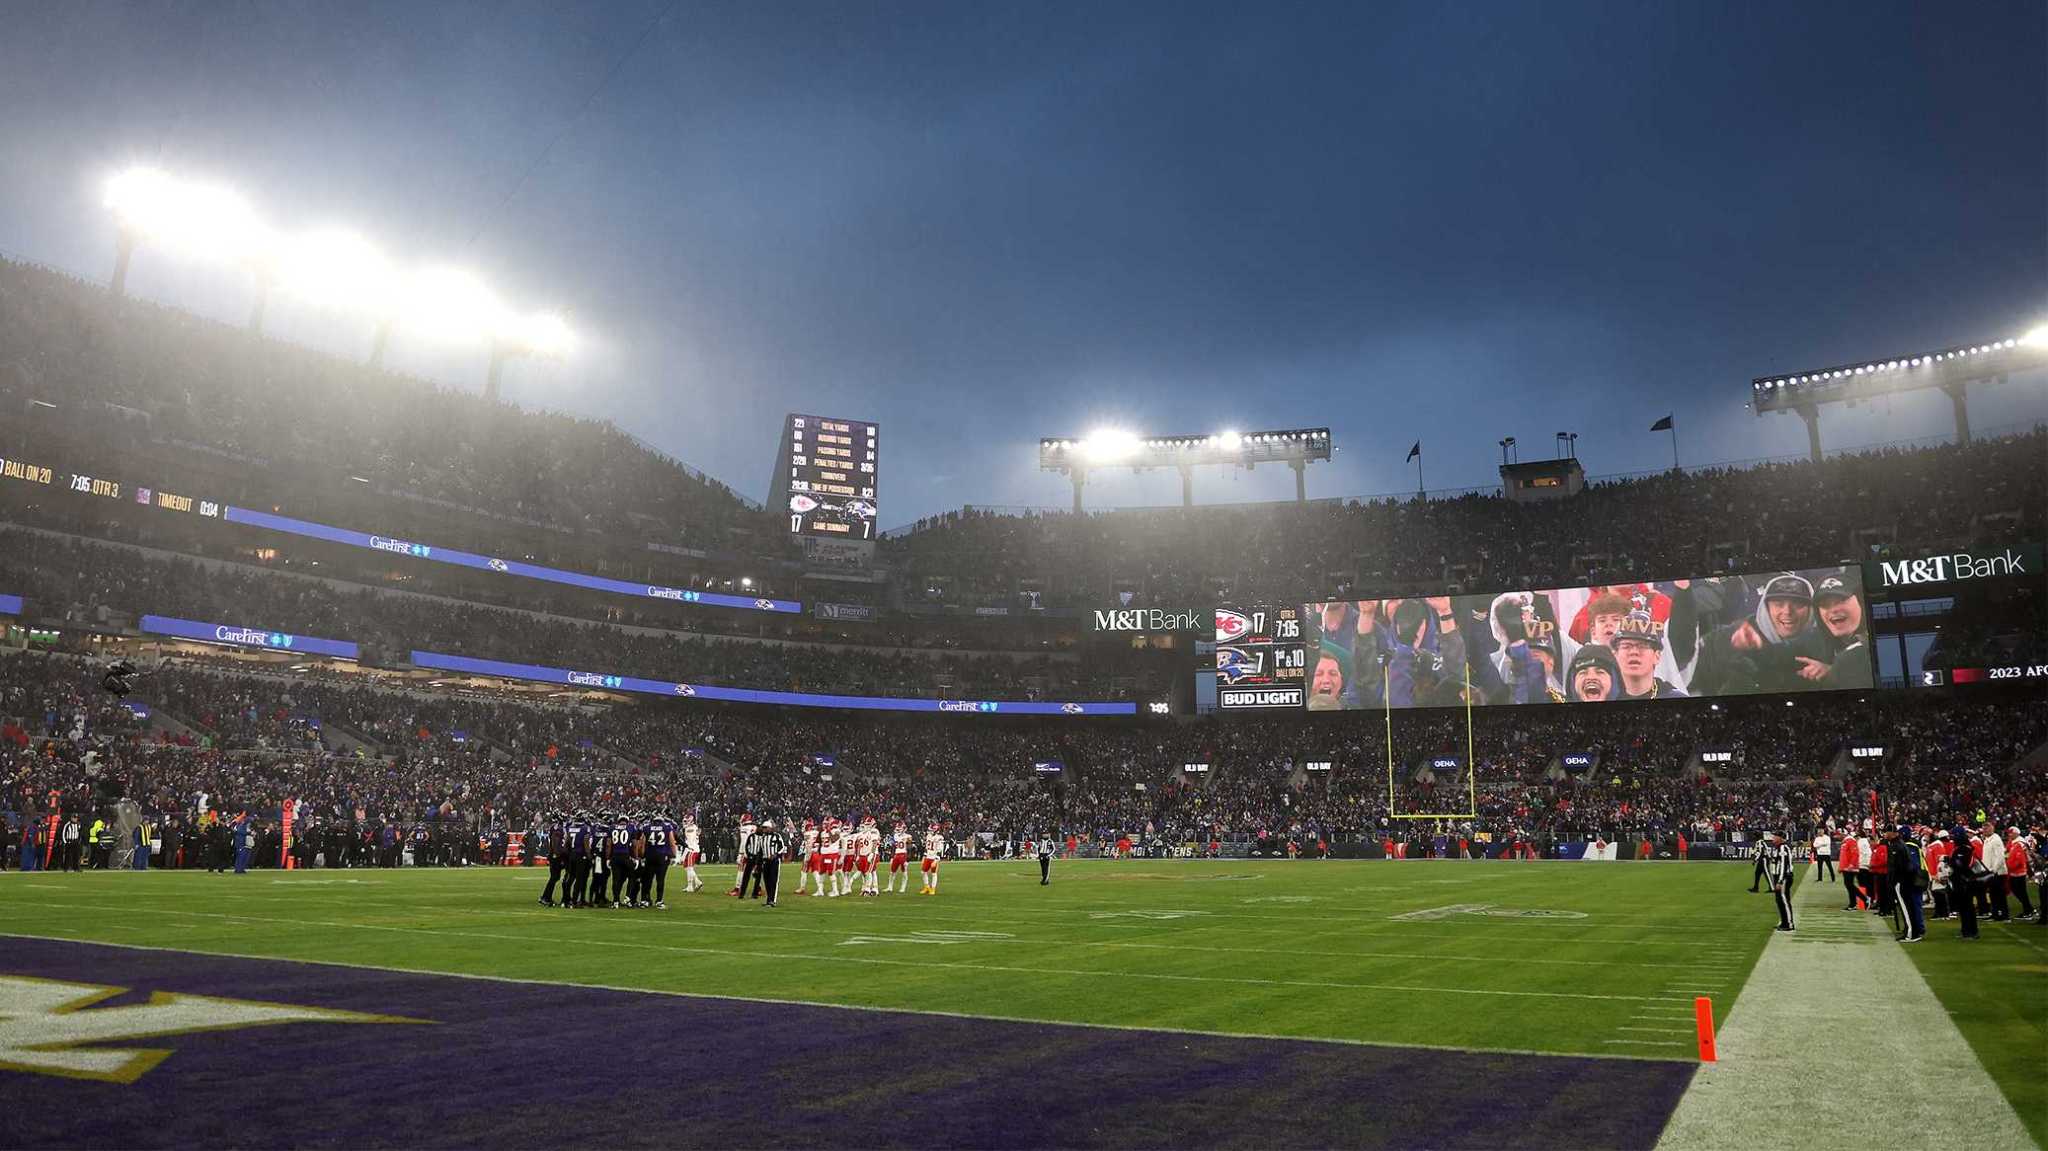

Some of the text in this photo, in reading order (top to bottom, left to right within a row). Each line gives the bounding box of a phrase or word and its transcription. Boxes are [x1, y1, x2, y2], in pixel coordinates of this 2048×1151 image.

[5, 460, 24, 479] BALL
[26, 465, 39, 482] ON
[40, 468, 52, 484] 20
[71, 474, 91, 492] 7:05
[111, 484, 118, 498] 3
[158, 492, 218, 517] TIMEOUT 0:04
[791, 515, 802, 532] 17
[864, 521, 870, 539] 7
[370, 535, 411, 555] CareFirst
[1880, 549, 2025, 586] M&T Bank
[648, 585, 683, 600] CareFirst
[1094, 609, 1200, 631] M&T Bank
[1252, 612, 1265, 633] 17
[1276, 620, 1299, 638] 7:05
[216, 625, 268, 646] CareFirst
[1256, 652, 1264, 673] 7
[1292, 649, 1304, 667] 10
[567, 671, 604, 686] CareFirst
[1989, 667, 2021, 679] 2023
[939, 700, 979, 712] CareFirst
[1224, 692, 1299, 704] BUD LIGHT
[570, 833, 576, 848] 7
[612, 830, 628, 845] 80
[648, 831, 666, 846] 42
